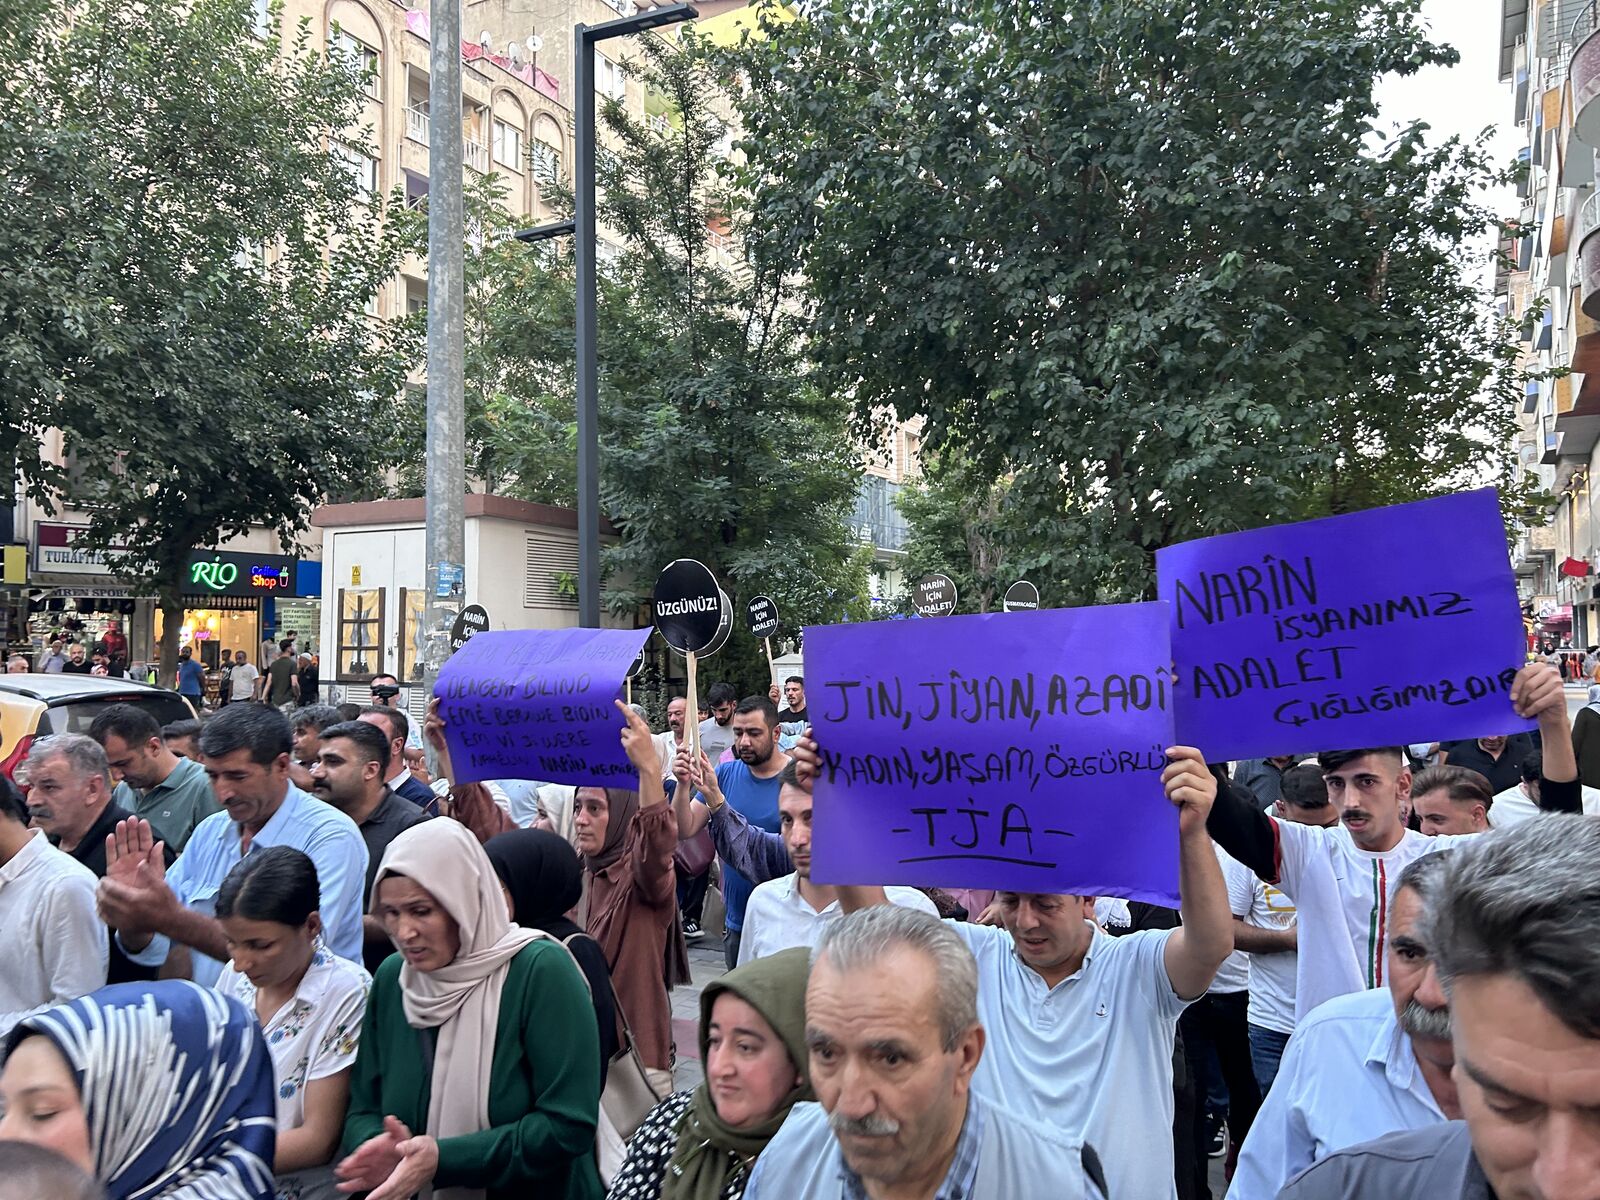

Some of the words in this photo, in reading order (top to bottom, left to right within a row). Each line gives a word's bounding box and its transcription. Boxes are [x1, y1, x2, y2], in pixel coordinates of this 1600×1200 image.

[192, 556, 238, 590] RİO
[252, 575, 277, 589] Shop
[920, 579, 946, 591] NARİN
[656, 595, 718, 617] ÜZGÜNÜZ!
[750, 600, 769, 613] NARİN
[919, 601, 952, 614] ADALET!
[463, 611, 485, 625] NARİN
[754, 612, 768, 621] İÇİN
[1273, 592, 1474, 642] İSYANIMIZ
[752, 619, 776, 633] ADALET!
[1193, 646, 1358, 699] ADALET
